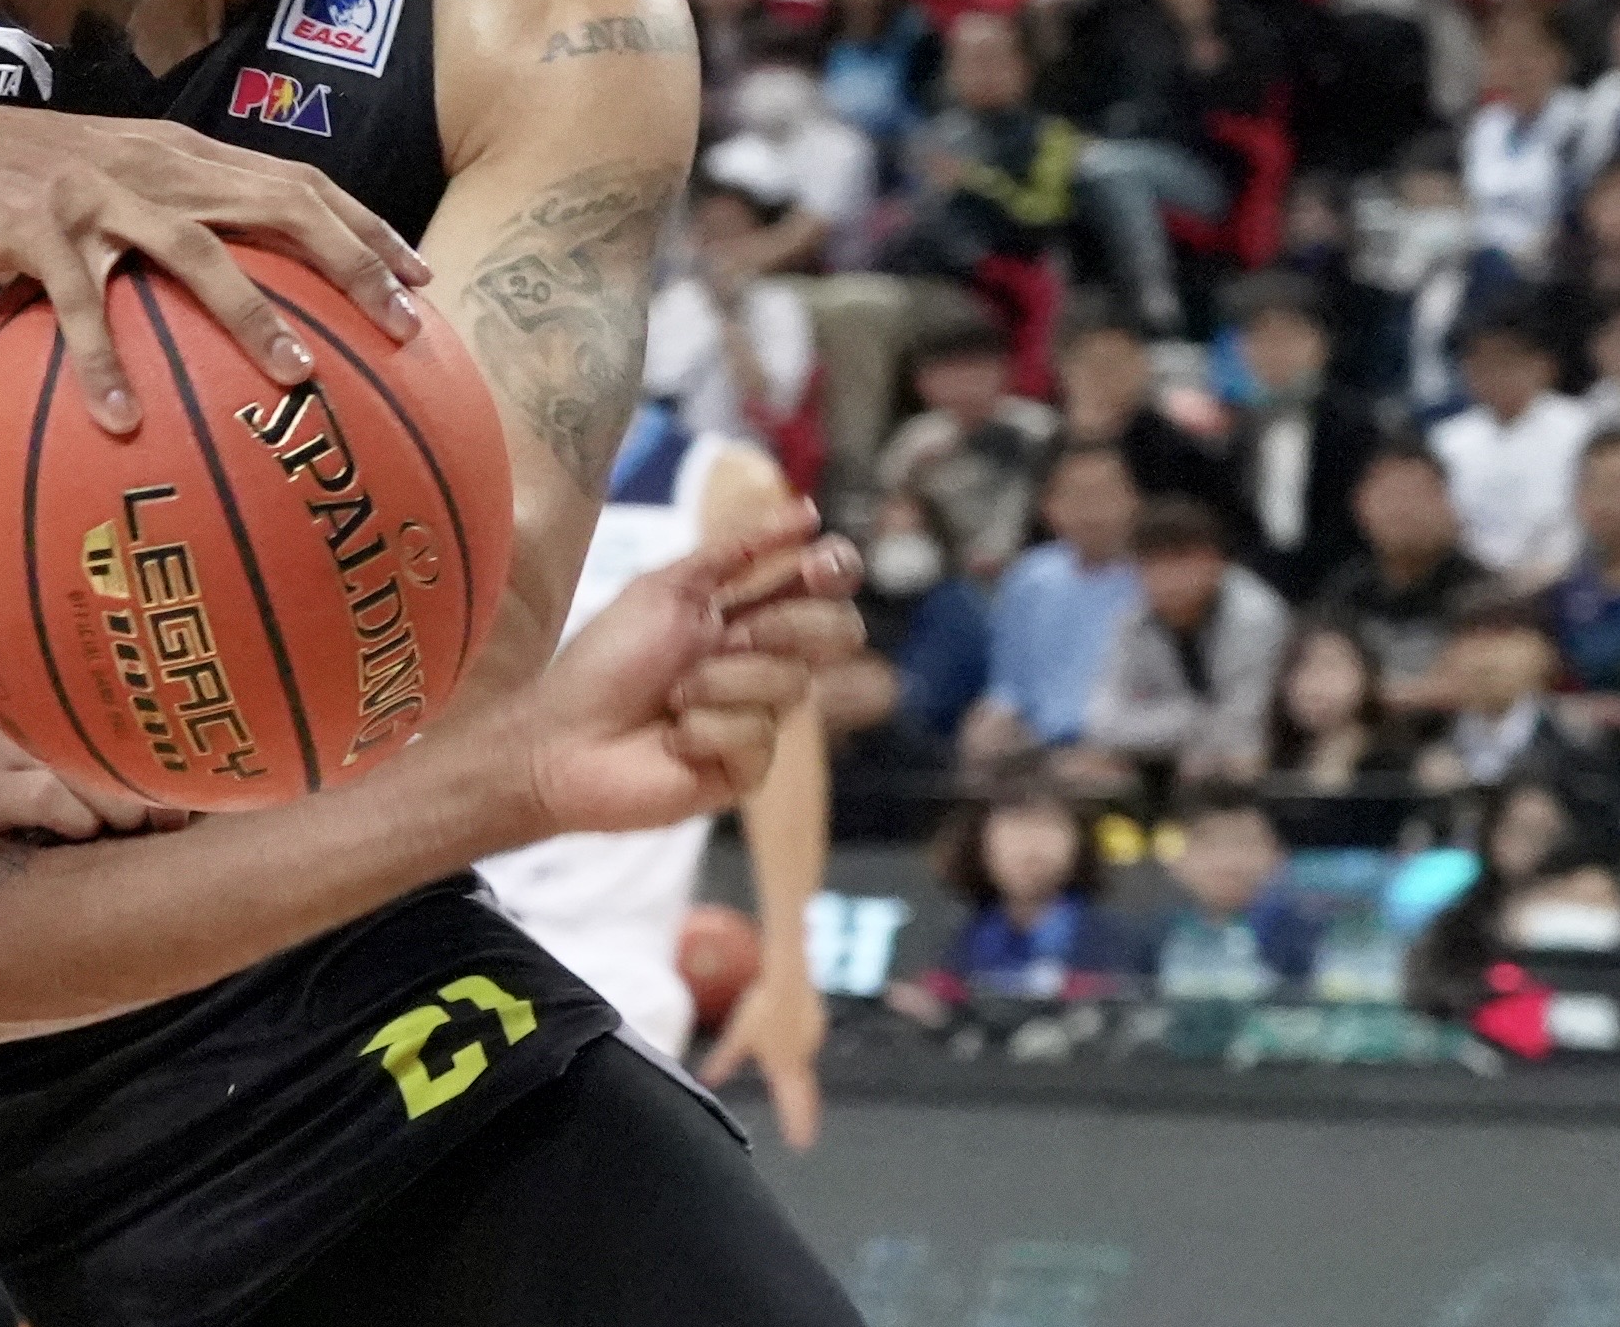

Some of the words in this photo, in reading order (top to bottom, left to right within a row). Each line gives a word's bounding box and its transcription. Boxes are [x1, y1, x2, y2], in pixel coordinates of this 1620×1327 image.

[228, 67, 332, 138] PBA
[292, 19, 367, 54] EASL
[123, 484, 268, 781] LEGACY
[234, 380, 426, 766] SPALDING
